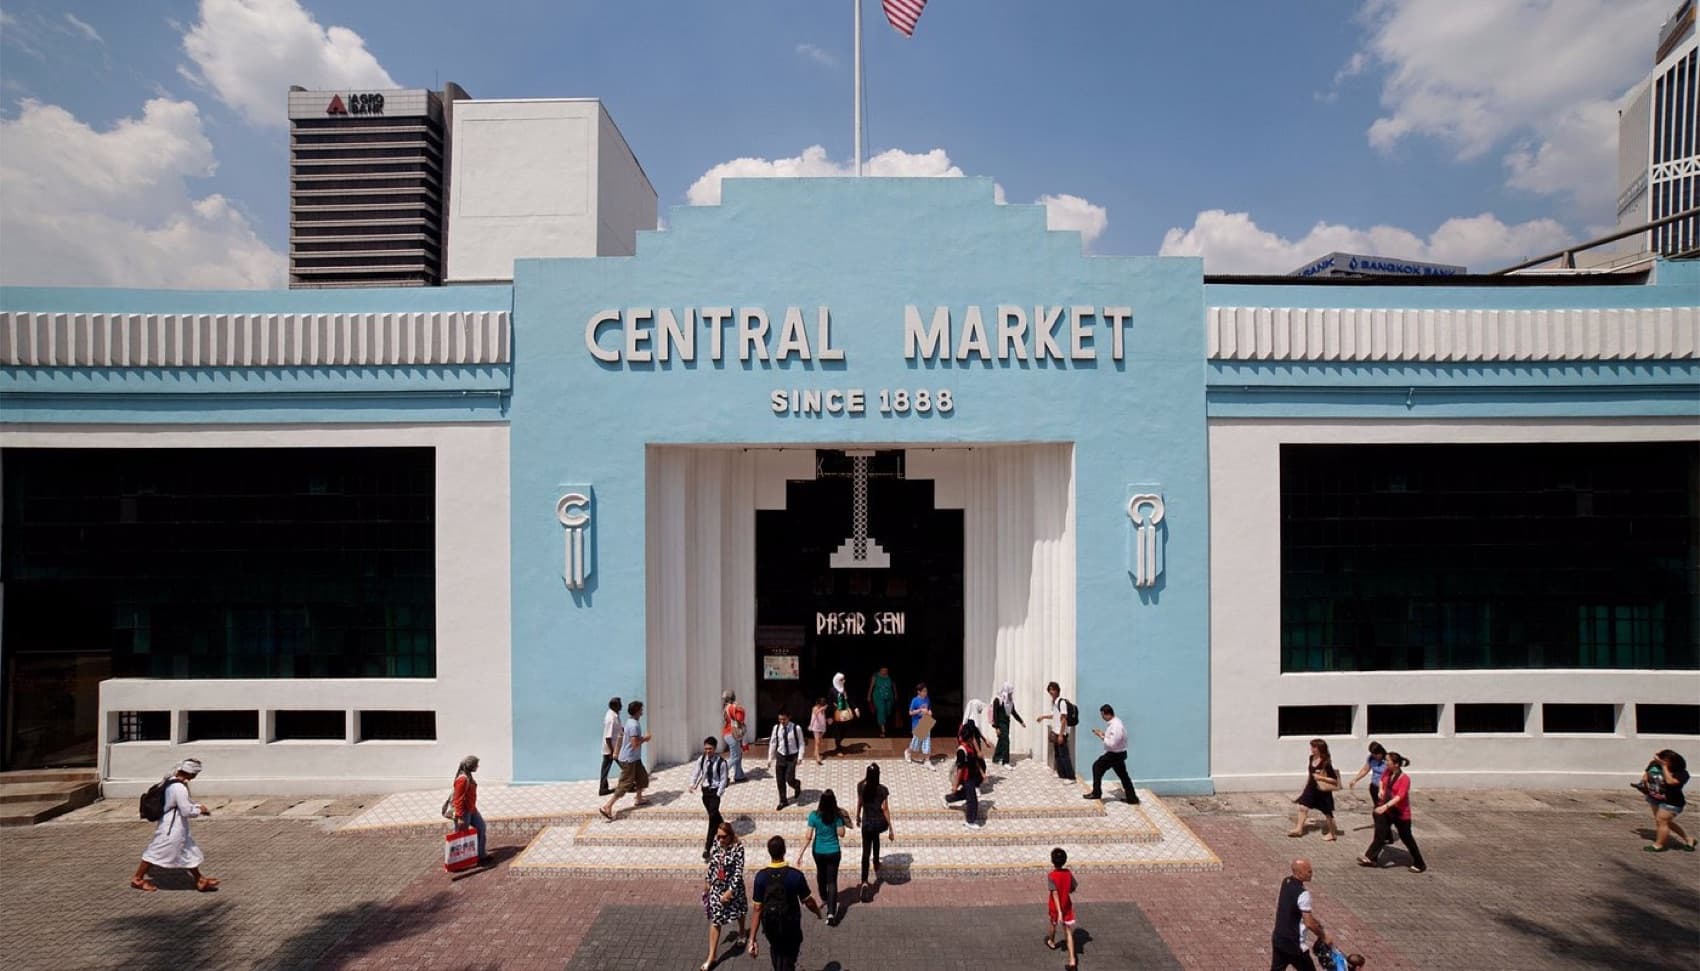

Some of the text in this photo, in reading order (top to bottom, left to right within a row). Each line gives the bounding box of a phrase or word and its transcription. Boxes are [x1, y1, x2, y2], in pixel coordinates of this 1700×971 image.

[1360, 260, 1421, 275] BANGKOK
[584, 304, 1133, 364] CENTRAL MARKET
[770, 388, 954, 413] SINCE 1888
[816, 612, 905, 635] PASAR SENI
